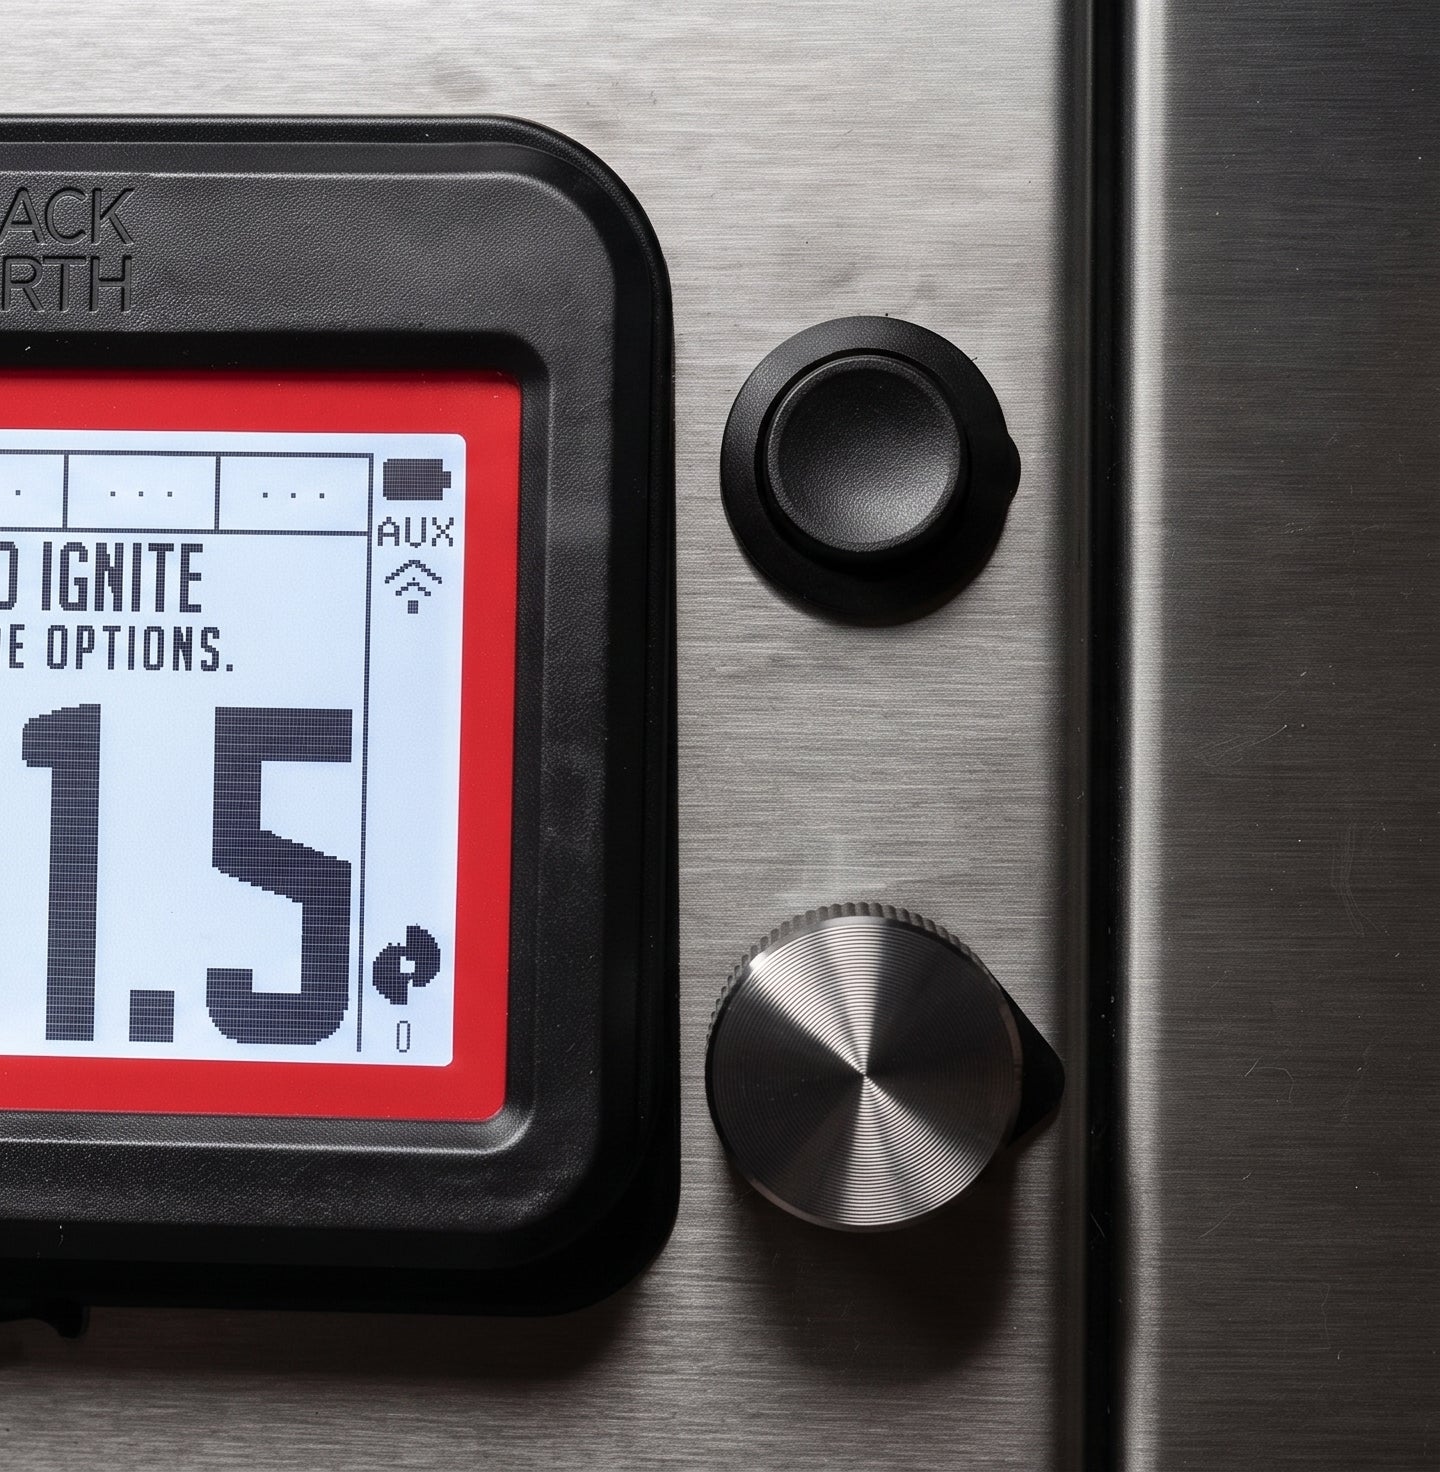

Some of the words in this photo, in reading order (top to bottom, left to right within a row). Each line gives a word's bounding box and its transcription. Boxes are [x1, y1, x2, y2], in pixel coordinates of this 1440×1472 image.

[377, 516, 454, 548] AUX
[41, 541, 204, 613] IGNITE
[46, 625, 234, 672] OPTIONS.
